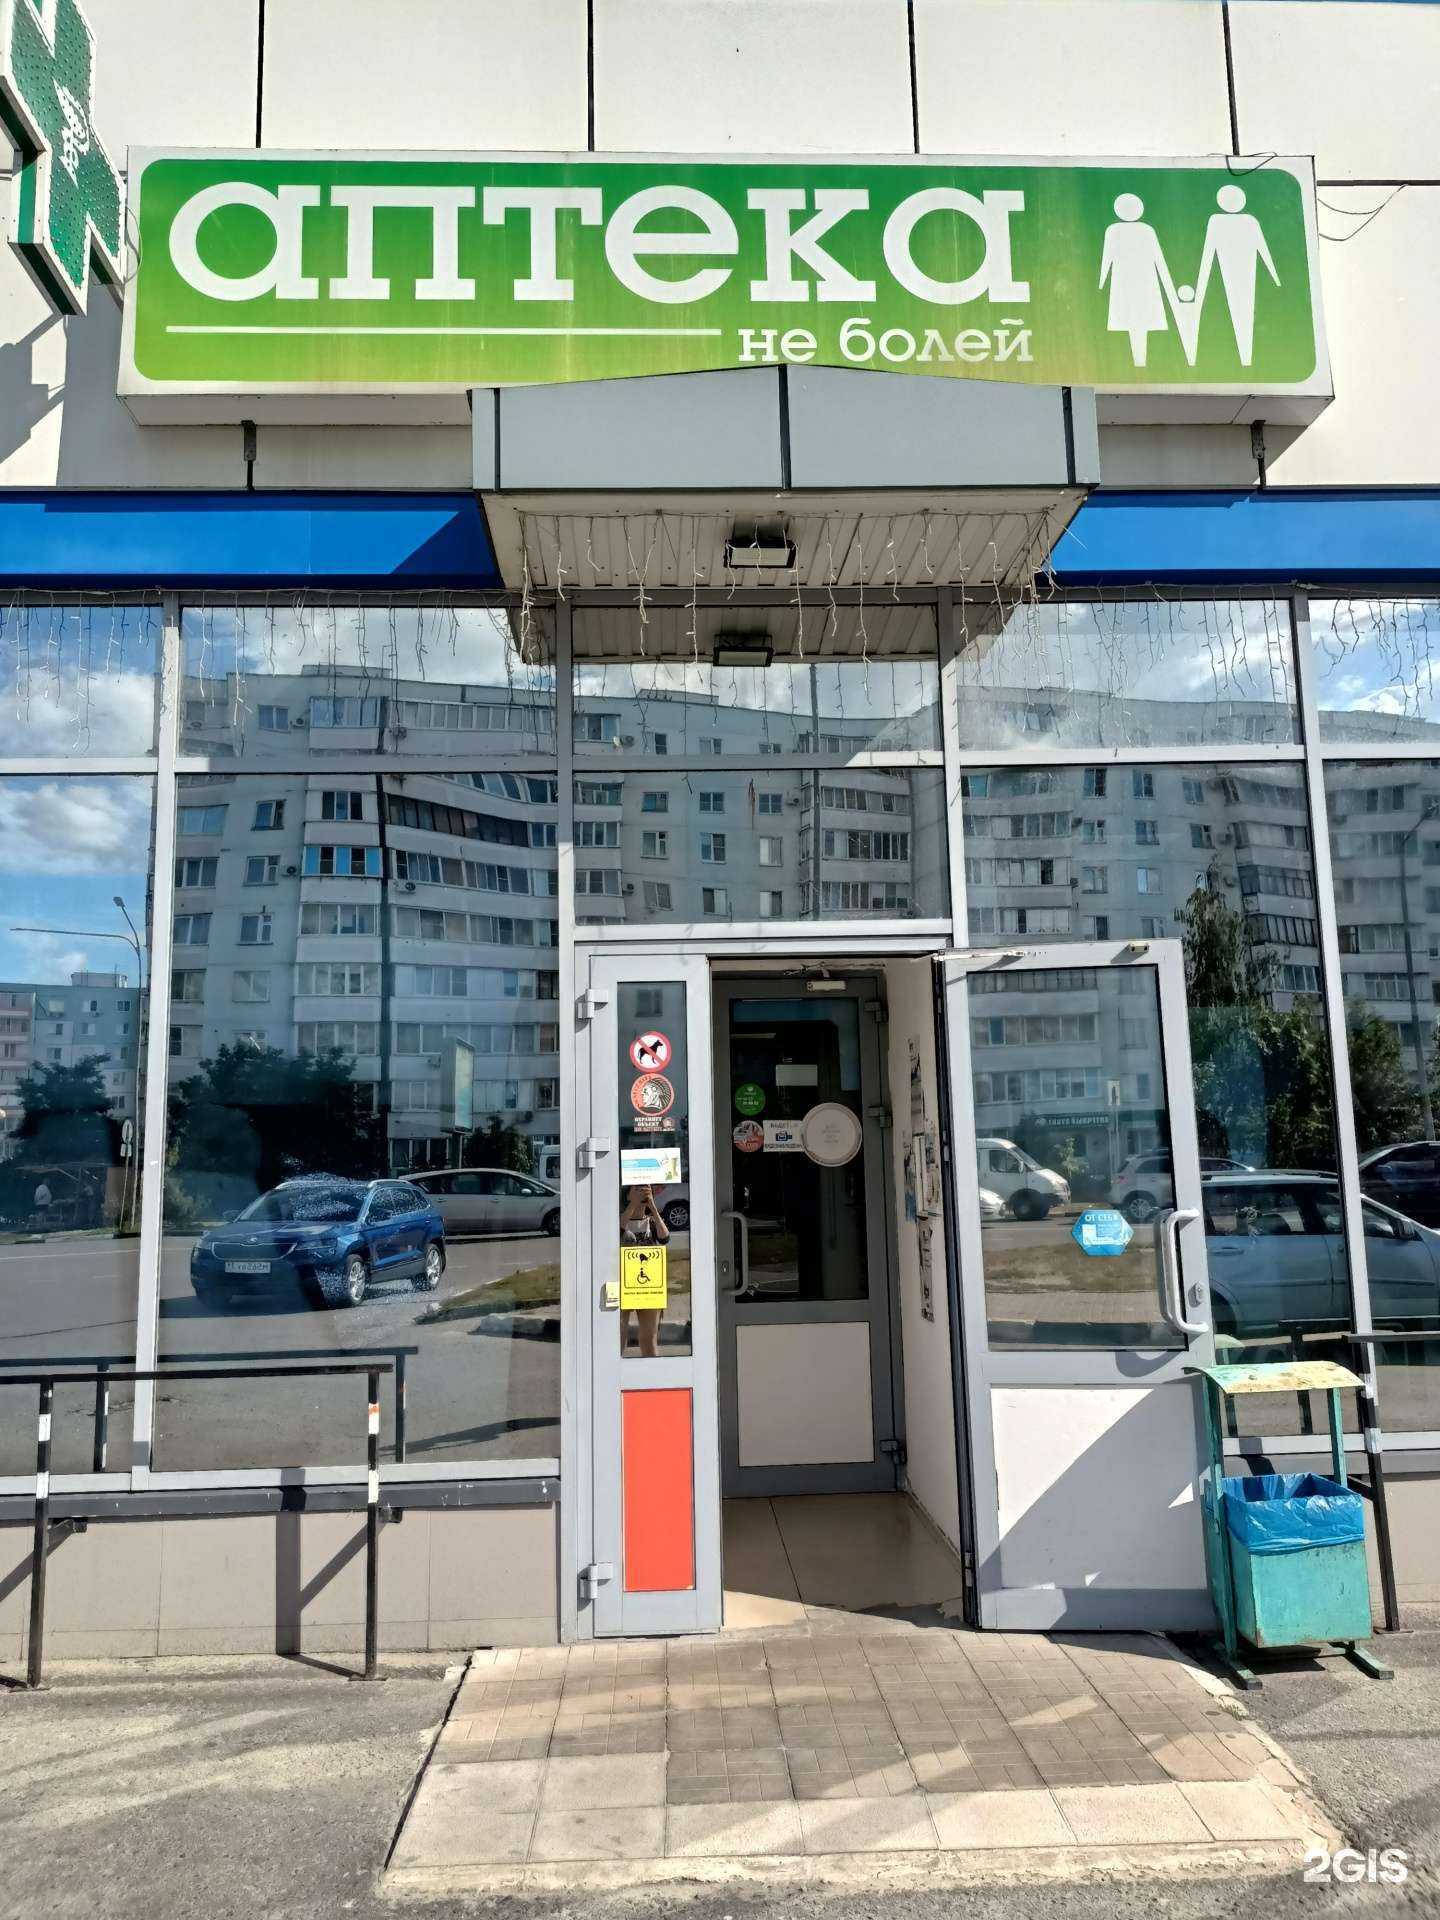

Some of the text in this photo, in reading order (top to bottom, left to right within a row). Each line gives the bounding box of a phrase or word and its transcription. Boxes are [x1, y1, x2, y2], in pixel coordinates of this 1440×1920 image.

[168, 181, 1031, 305] аптека
[738, 317, 1033, 363] не болей
